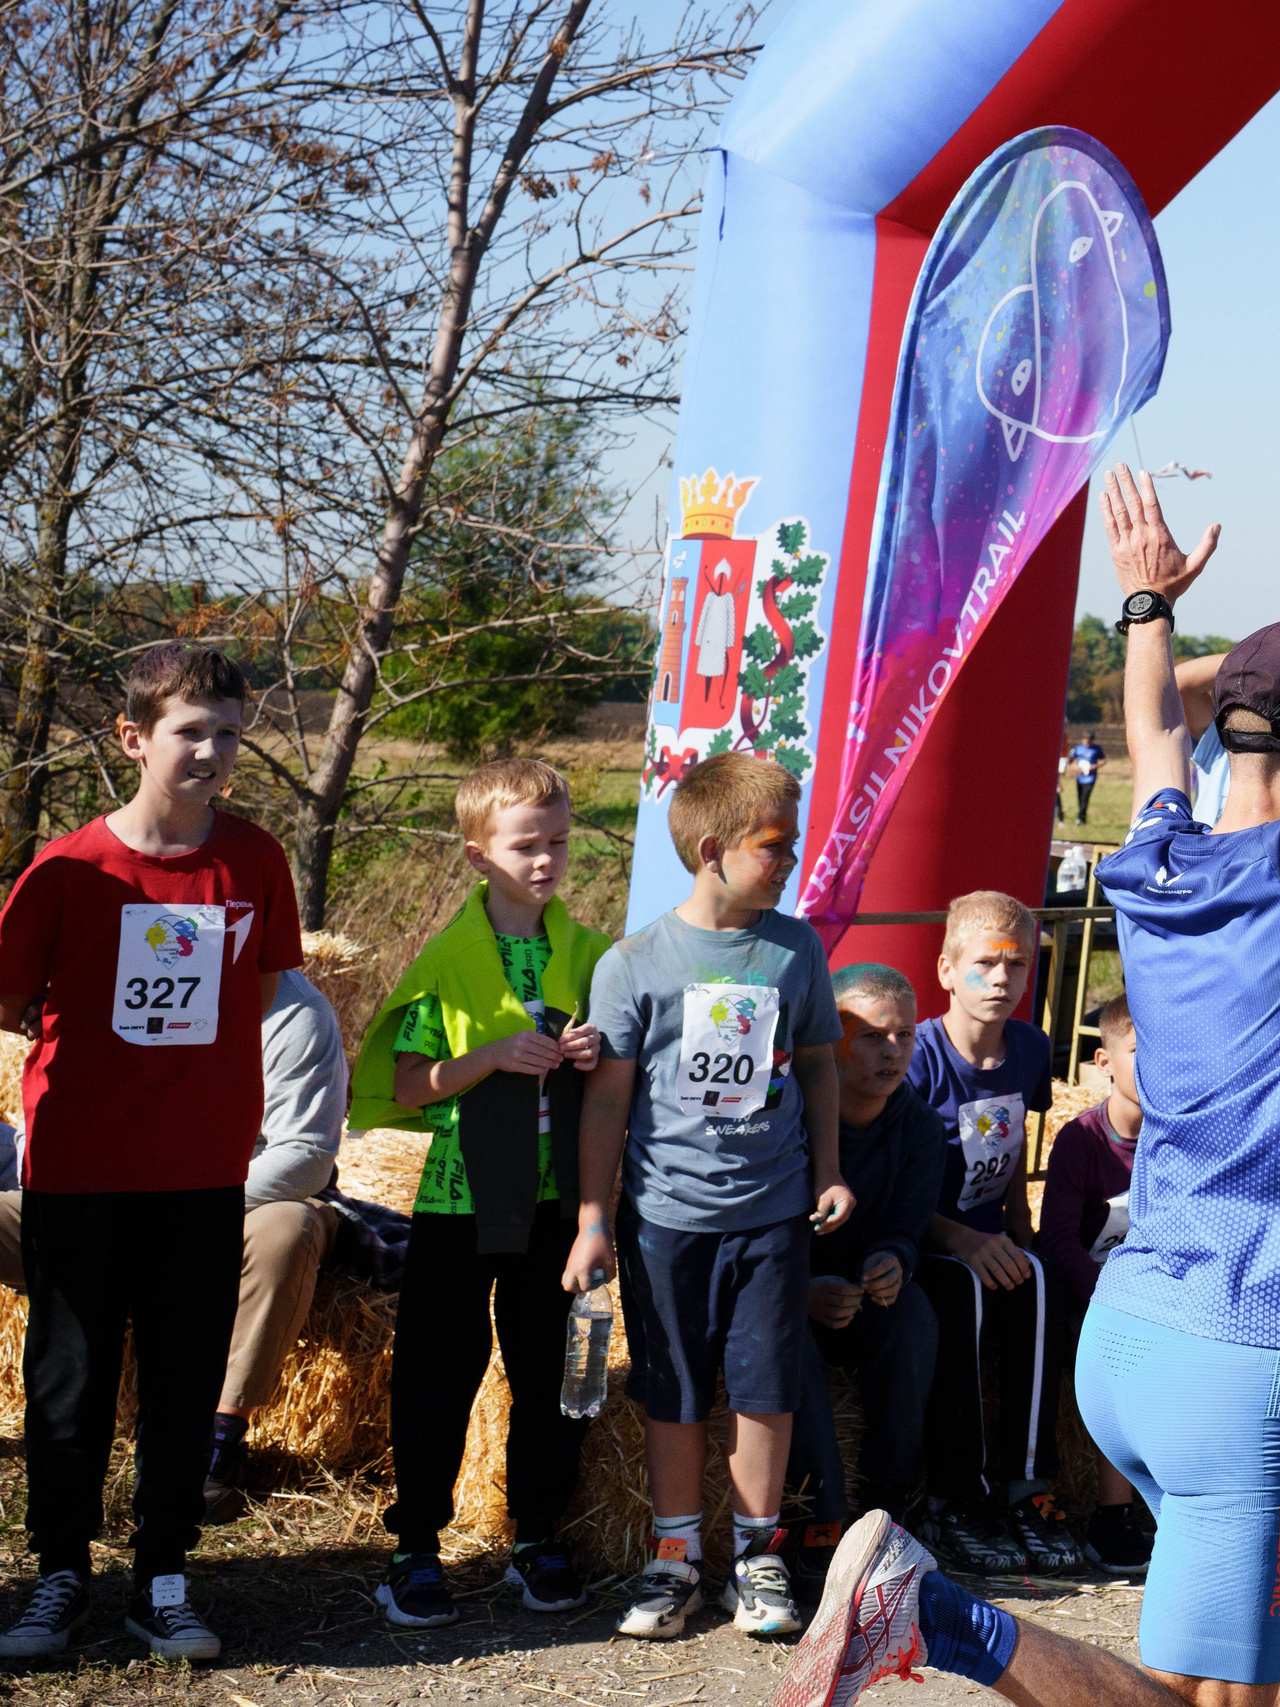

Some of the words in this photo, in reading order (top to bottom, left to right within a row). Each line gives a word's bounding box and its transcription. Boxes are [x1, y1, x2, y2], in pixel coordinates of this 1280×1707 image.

[525, 949, 535, 968] PRO
[124, 977, 201, 1010] 327
[521, 968, 538, 1003] FILA
[403, 1009, 419, 1042] FILA
[689, 1052, 755, 1085] 320
[705, 1121, 771, 1136] SNEAKERS
[436, 1159, 447, 1191] FILA
[450, 1158, 465, 1201] FILA
[969, 1153, 1011, 1187] 292
